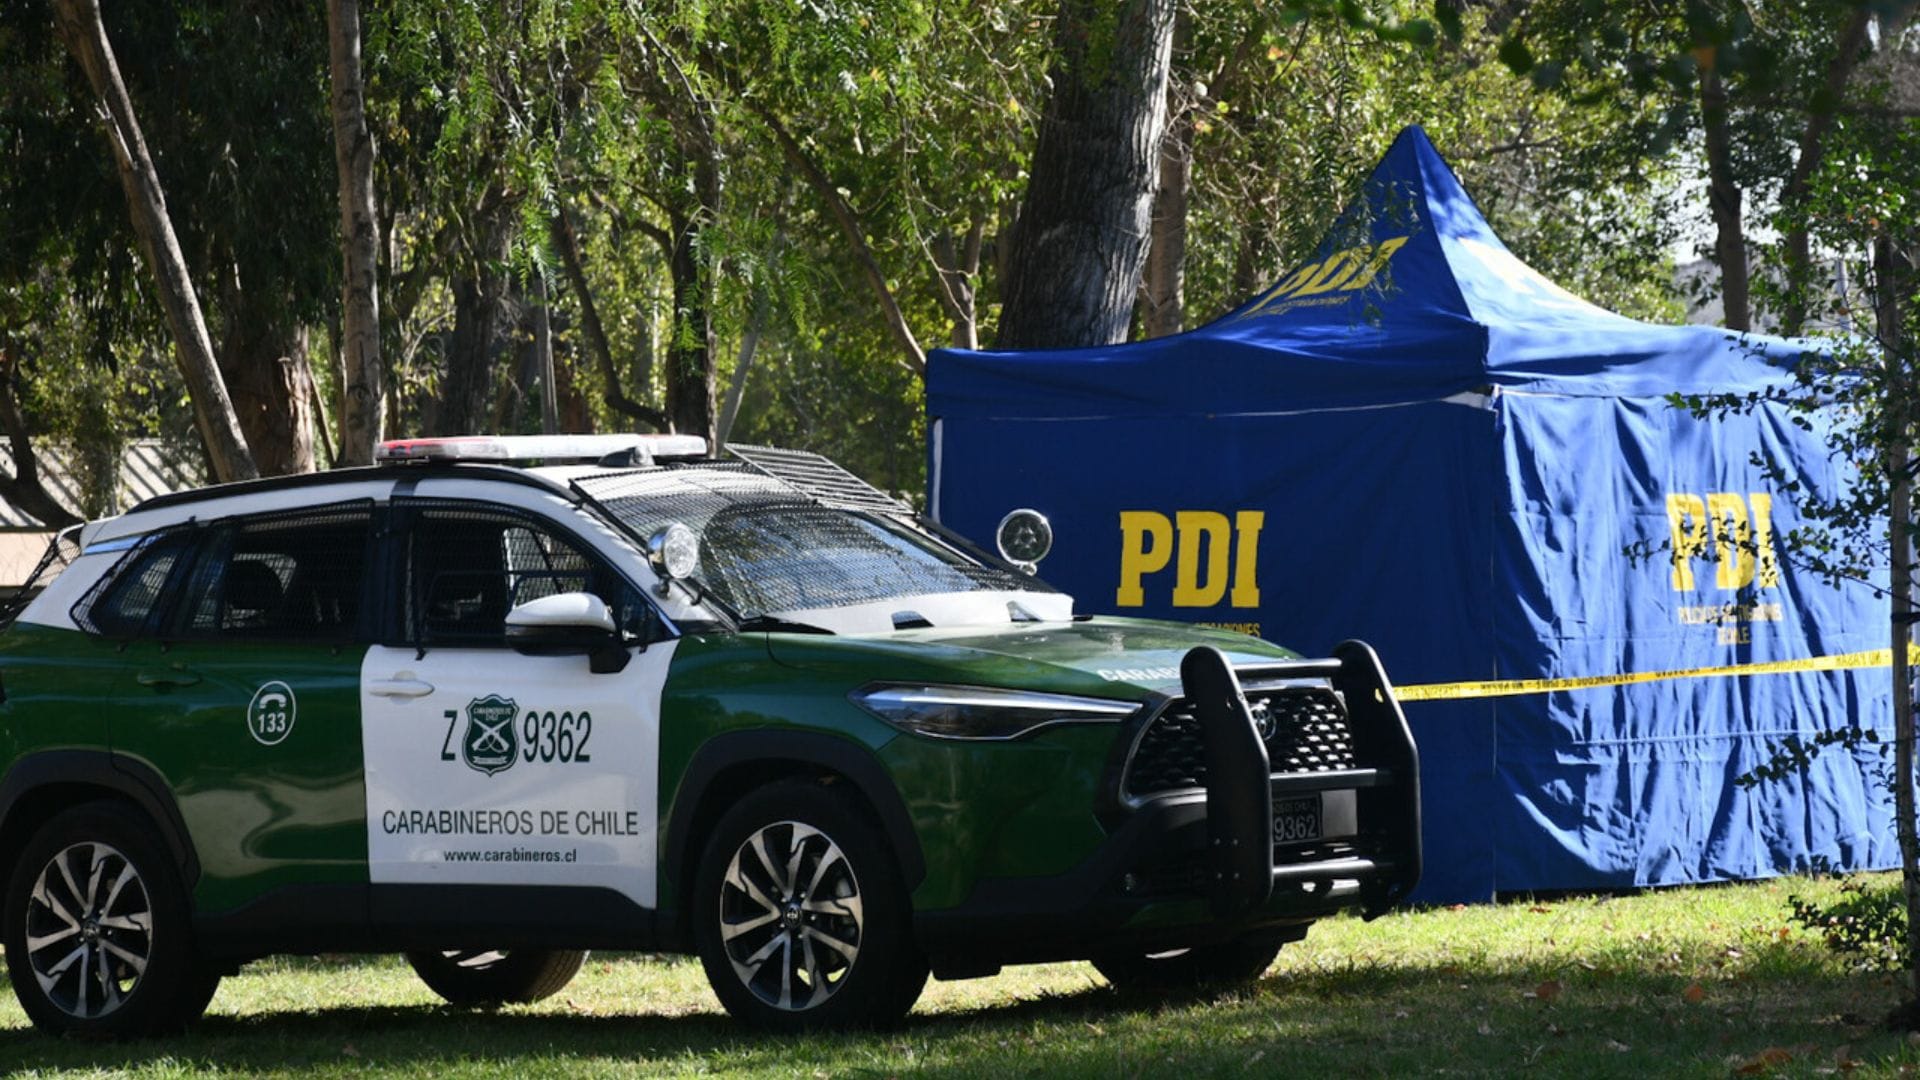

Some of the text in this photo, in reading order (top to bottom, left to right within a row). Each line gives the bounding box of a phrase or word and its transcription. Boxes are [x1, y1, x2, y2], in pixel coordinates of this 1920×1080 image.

[1238, 236, 1409, 318] PDI
[1666, 492, 1779, 591] PDI
[1116, 510, 1265, 608] PDI
[1097, 668, 1180, 681] CARAB
[257, 711, 287, 734] 133
[441, 709, 591, 763] Z 9362
[383, 810, 639, 836] CARABINEROS DE CHILE
[1274, 814, 1317, 841] 9362
[444, 847, 577, 864] www.carabineros.cl
